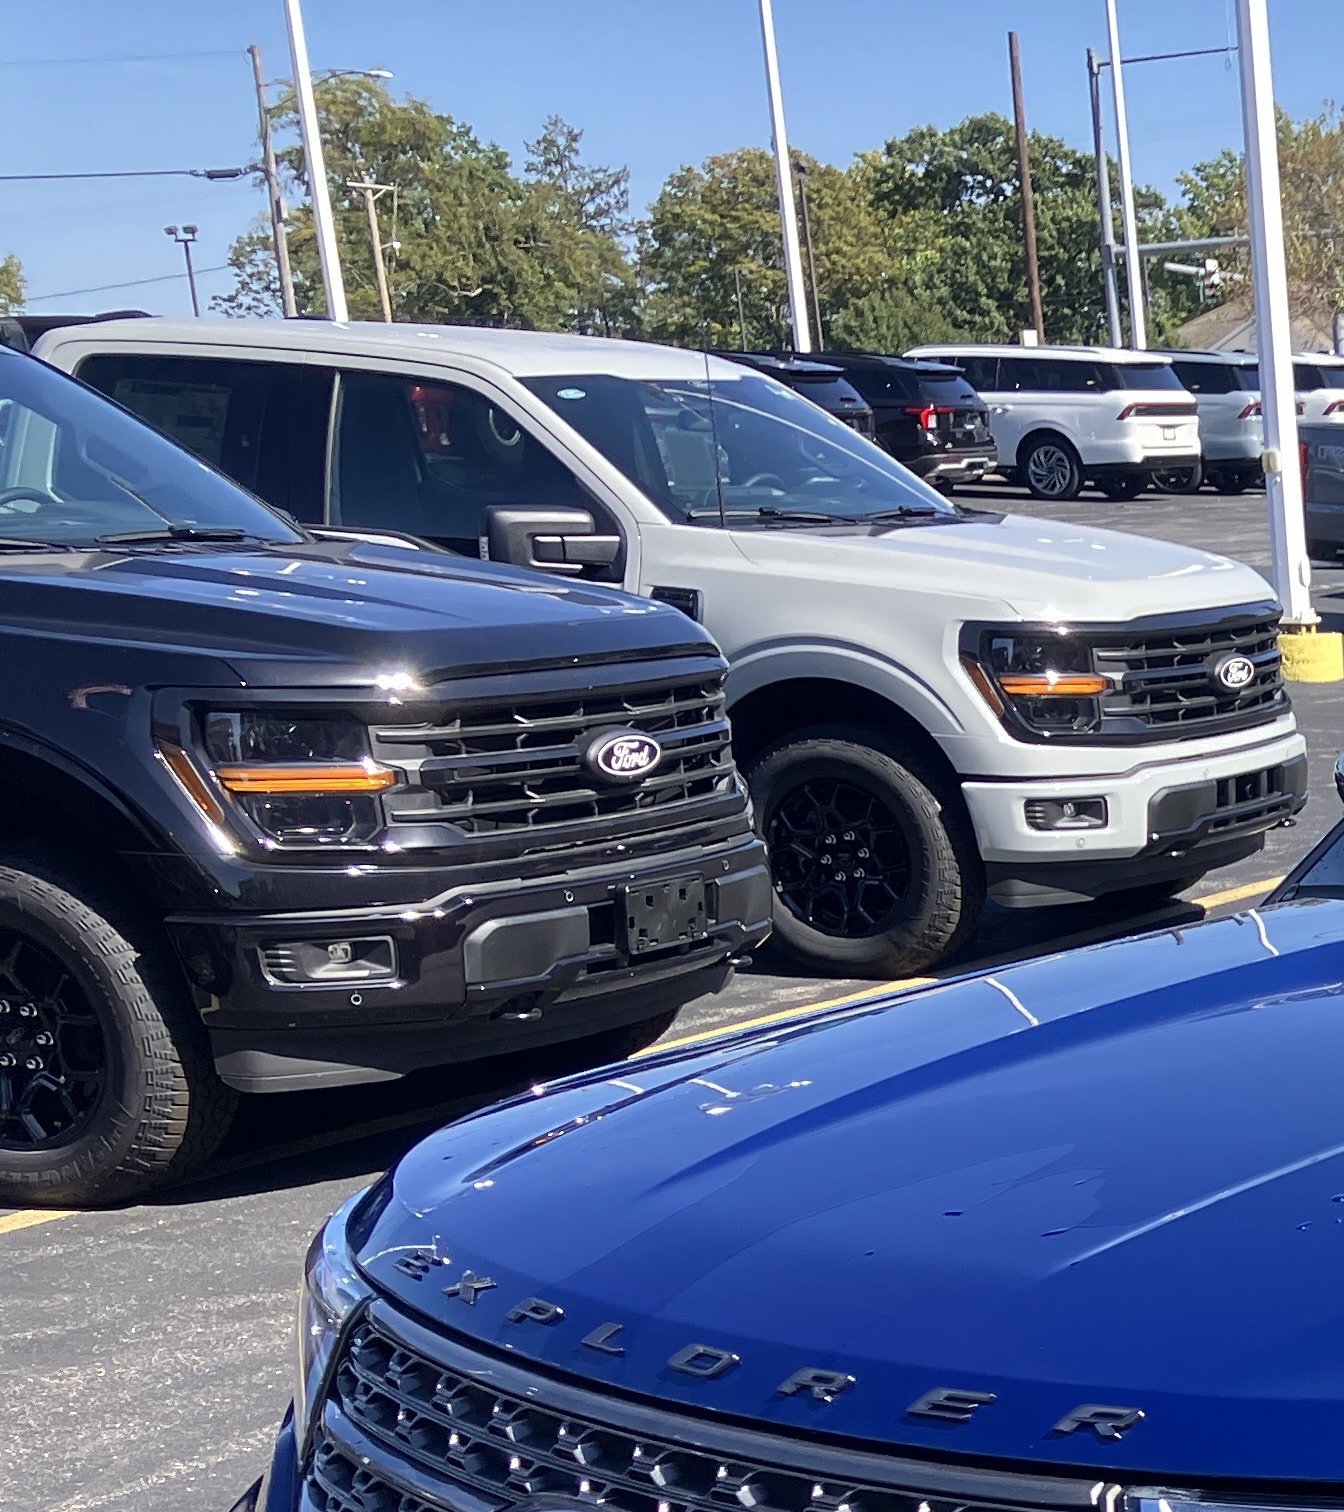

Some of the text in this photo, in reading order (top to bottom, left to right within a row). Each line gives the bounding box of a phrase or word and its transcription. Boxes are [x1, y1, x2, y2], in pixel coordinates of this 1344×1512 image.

[1226, 661, 1249, 685] Ford
[610, 740, 650, 771] Ford
[392, 1248, 1147, 1442] EXPLORER
